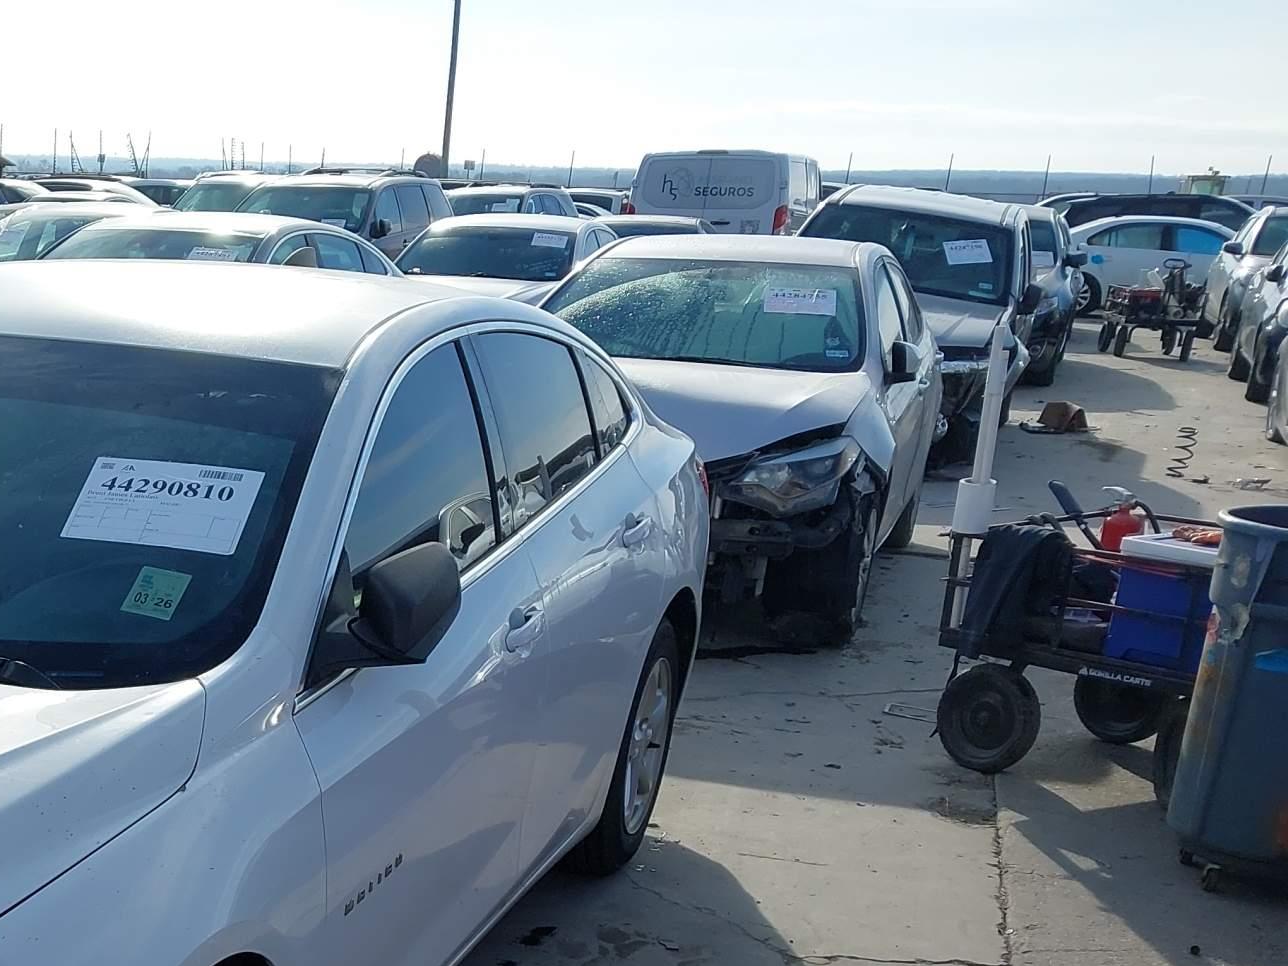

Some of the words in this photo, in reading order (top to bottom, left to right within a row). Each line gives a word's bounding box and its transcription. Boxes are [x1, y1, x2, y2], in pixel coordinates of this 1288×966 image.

[694, 186, 754, 197] SEGUROS
[101, 476, 235, 502] 44290810
[134, 592, 150, 605] 03
[153, 597, 174, 609] 26
[1089, 668, 1122, 681] GORILLA
[343, 853, 403, 917] MALIBU
